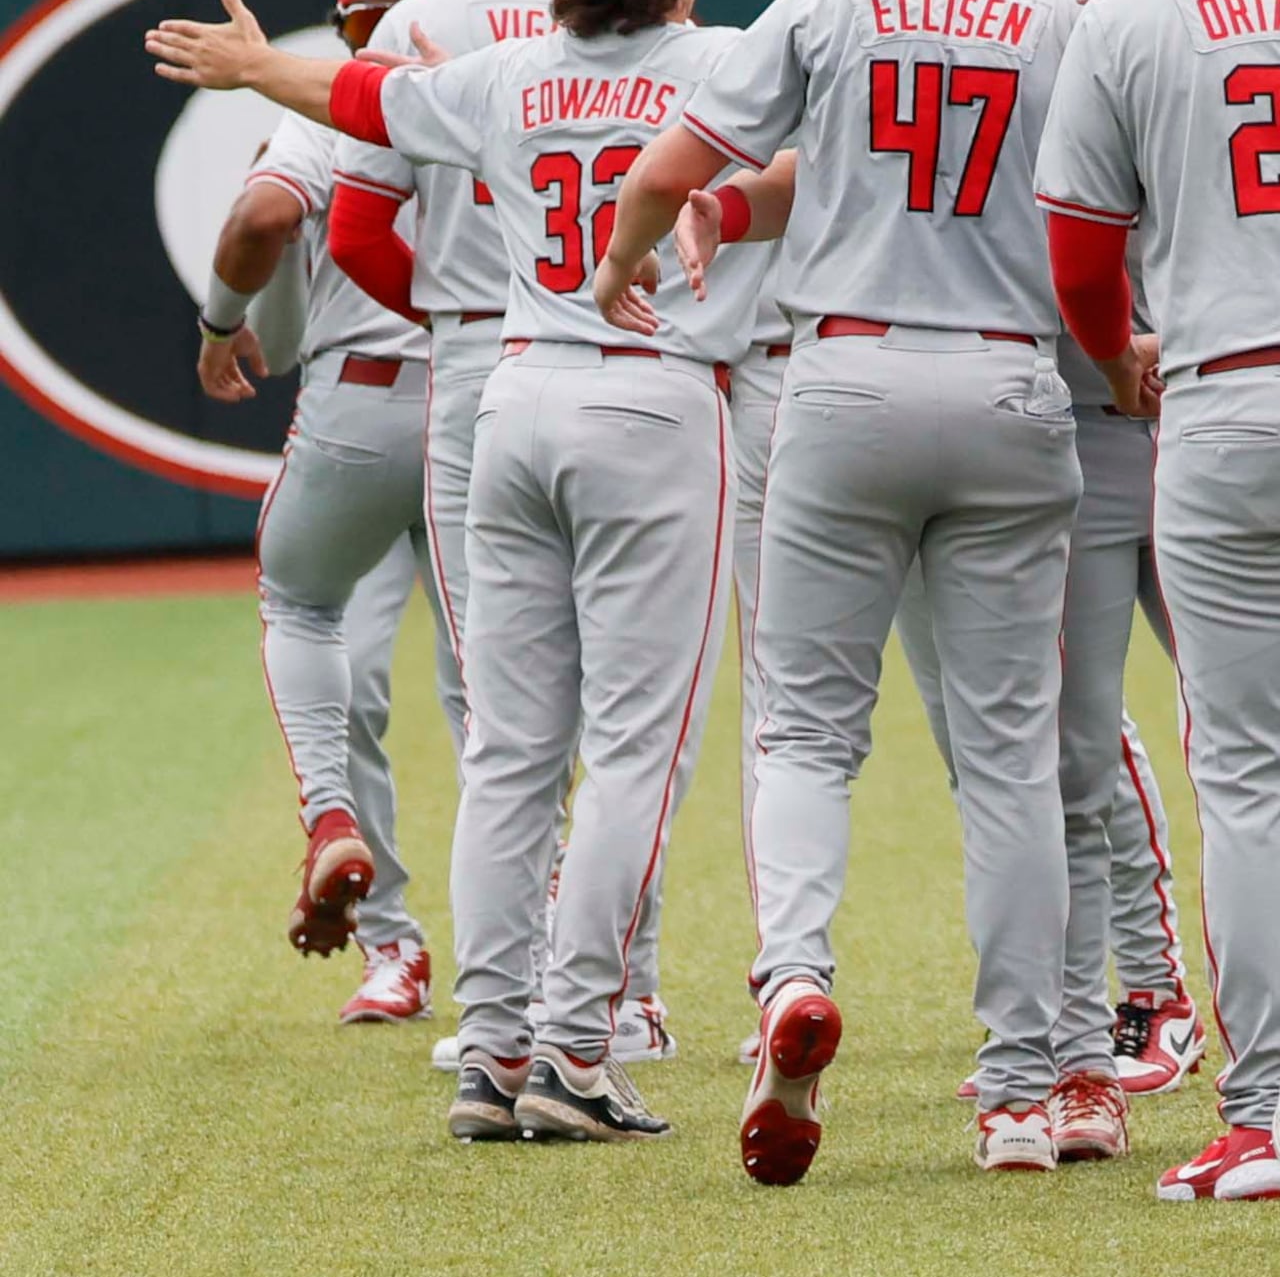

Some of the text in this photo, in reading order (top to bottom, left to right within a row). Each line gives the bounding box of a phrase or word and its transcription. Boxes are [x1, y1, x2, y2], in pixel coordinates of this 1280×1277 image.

[486, 7, 558, 42] VIG
[521, 76, 676, 129] EDWARDS
[869, 59, 1020, 216] 47
